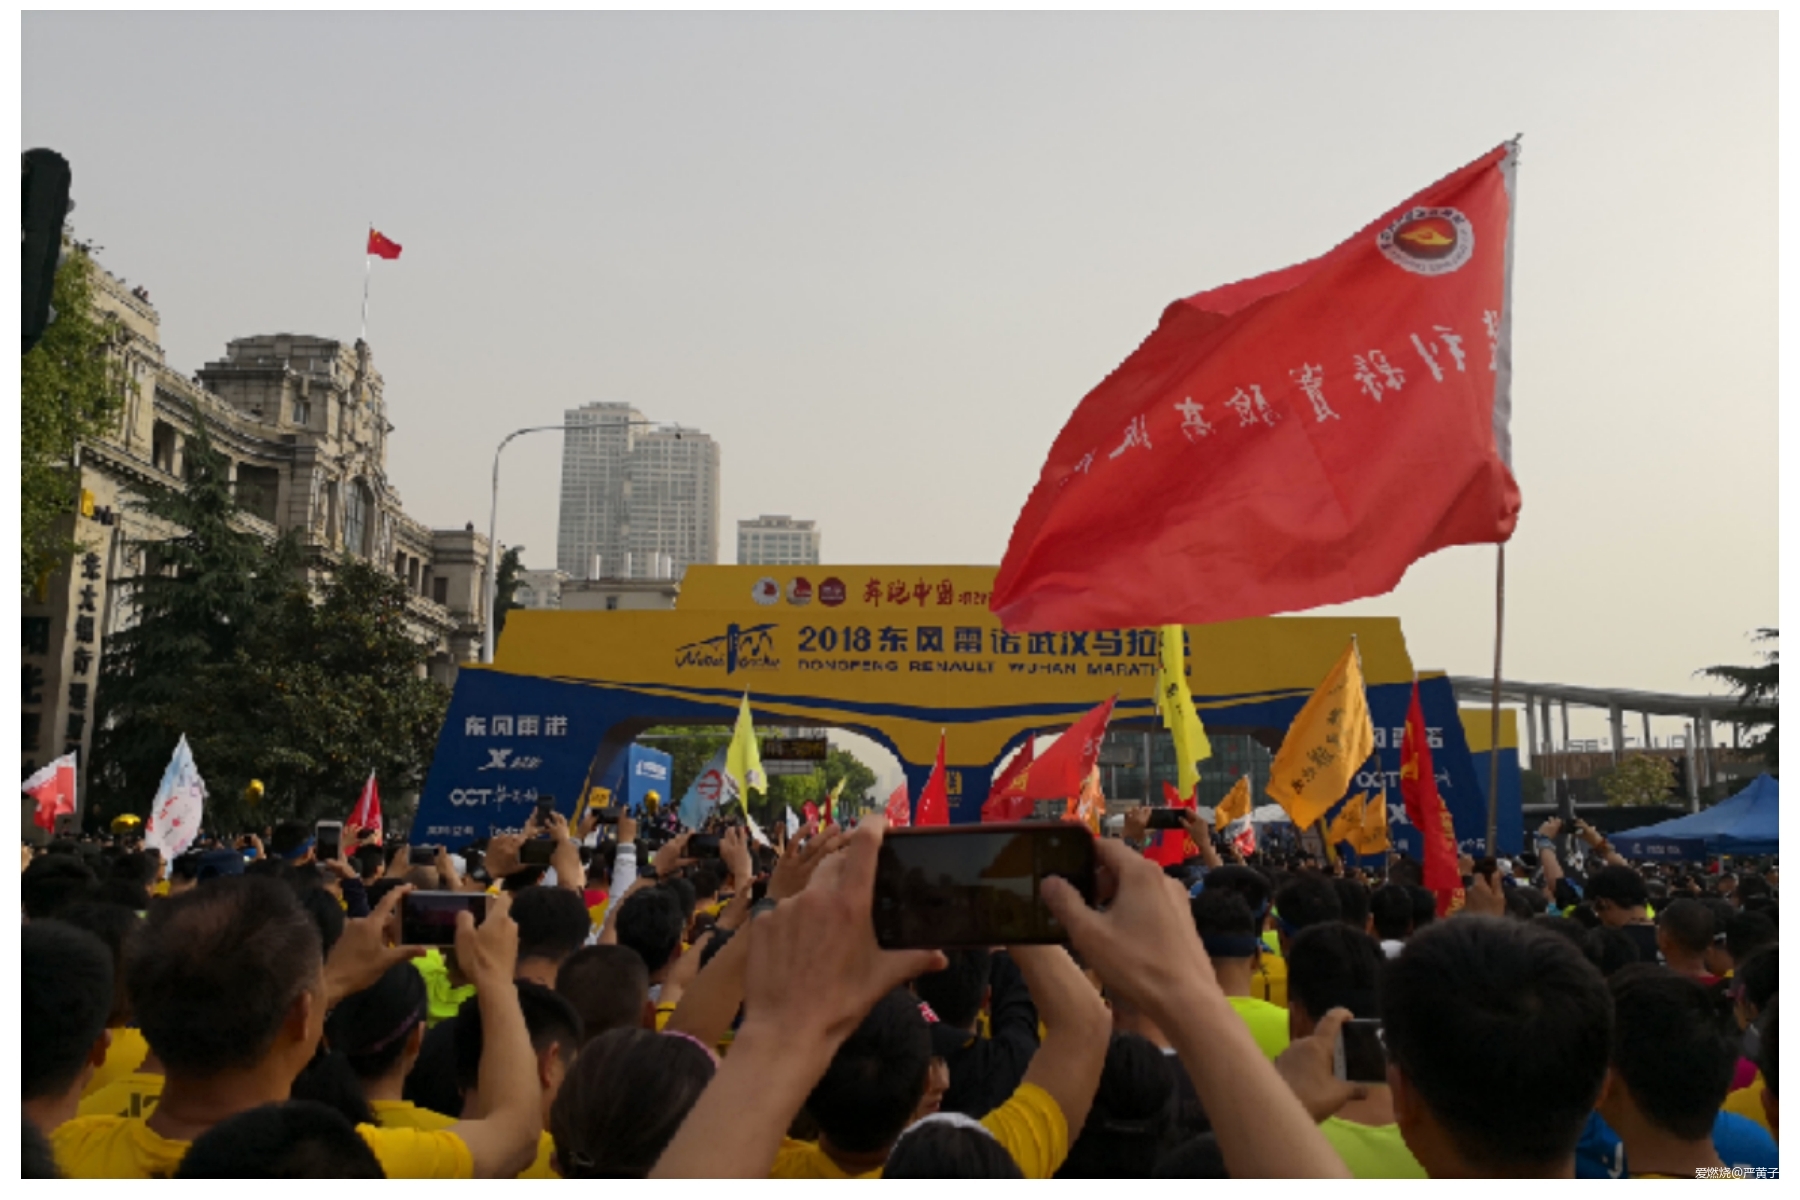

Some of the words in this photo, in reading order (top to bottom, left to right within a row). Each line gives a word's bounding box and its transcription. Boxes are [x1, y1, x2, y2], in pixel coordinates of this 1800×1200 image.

[798, 659, 899, 671] DONGFENG
[909, 660, 996, 673] RENAULT
[1008, 662, 1077, 674] WUHAN
[450, 788, 492, 806] OCT
